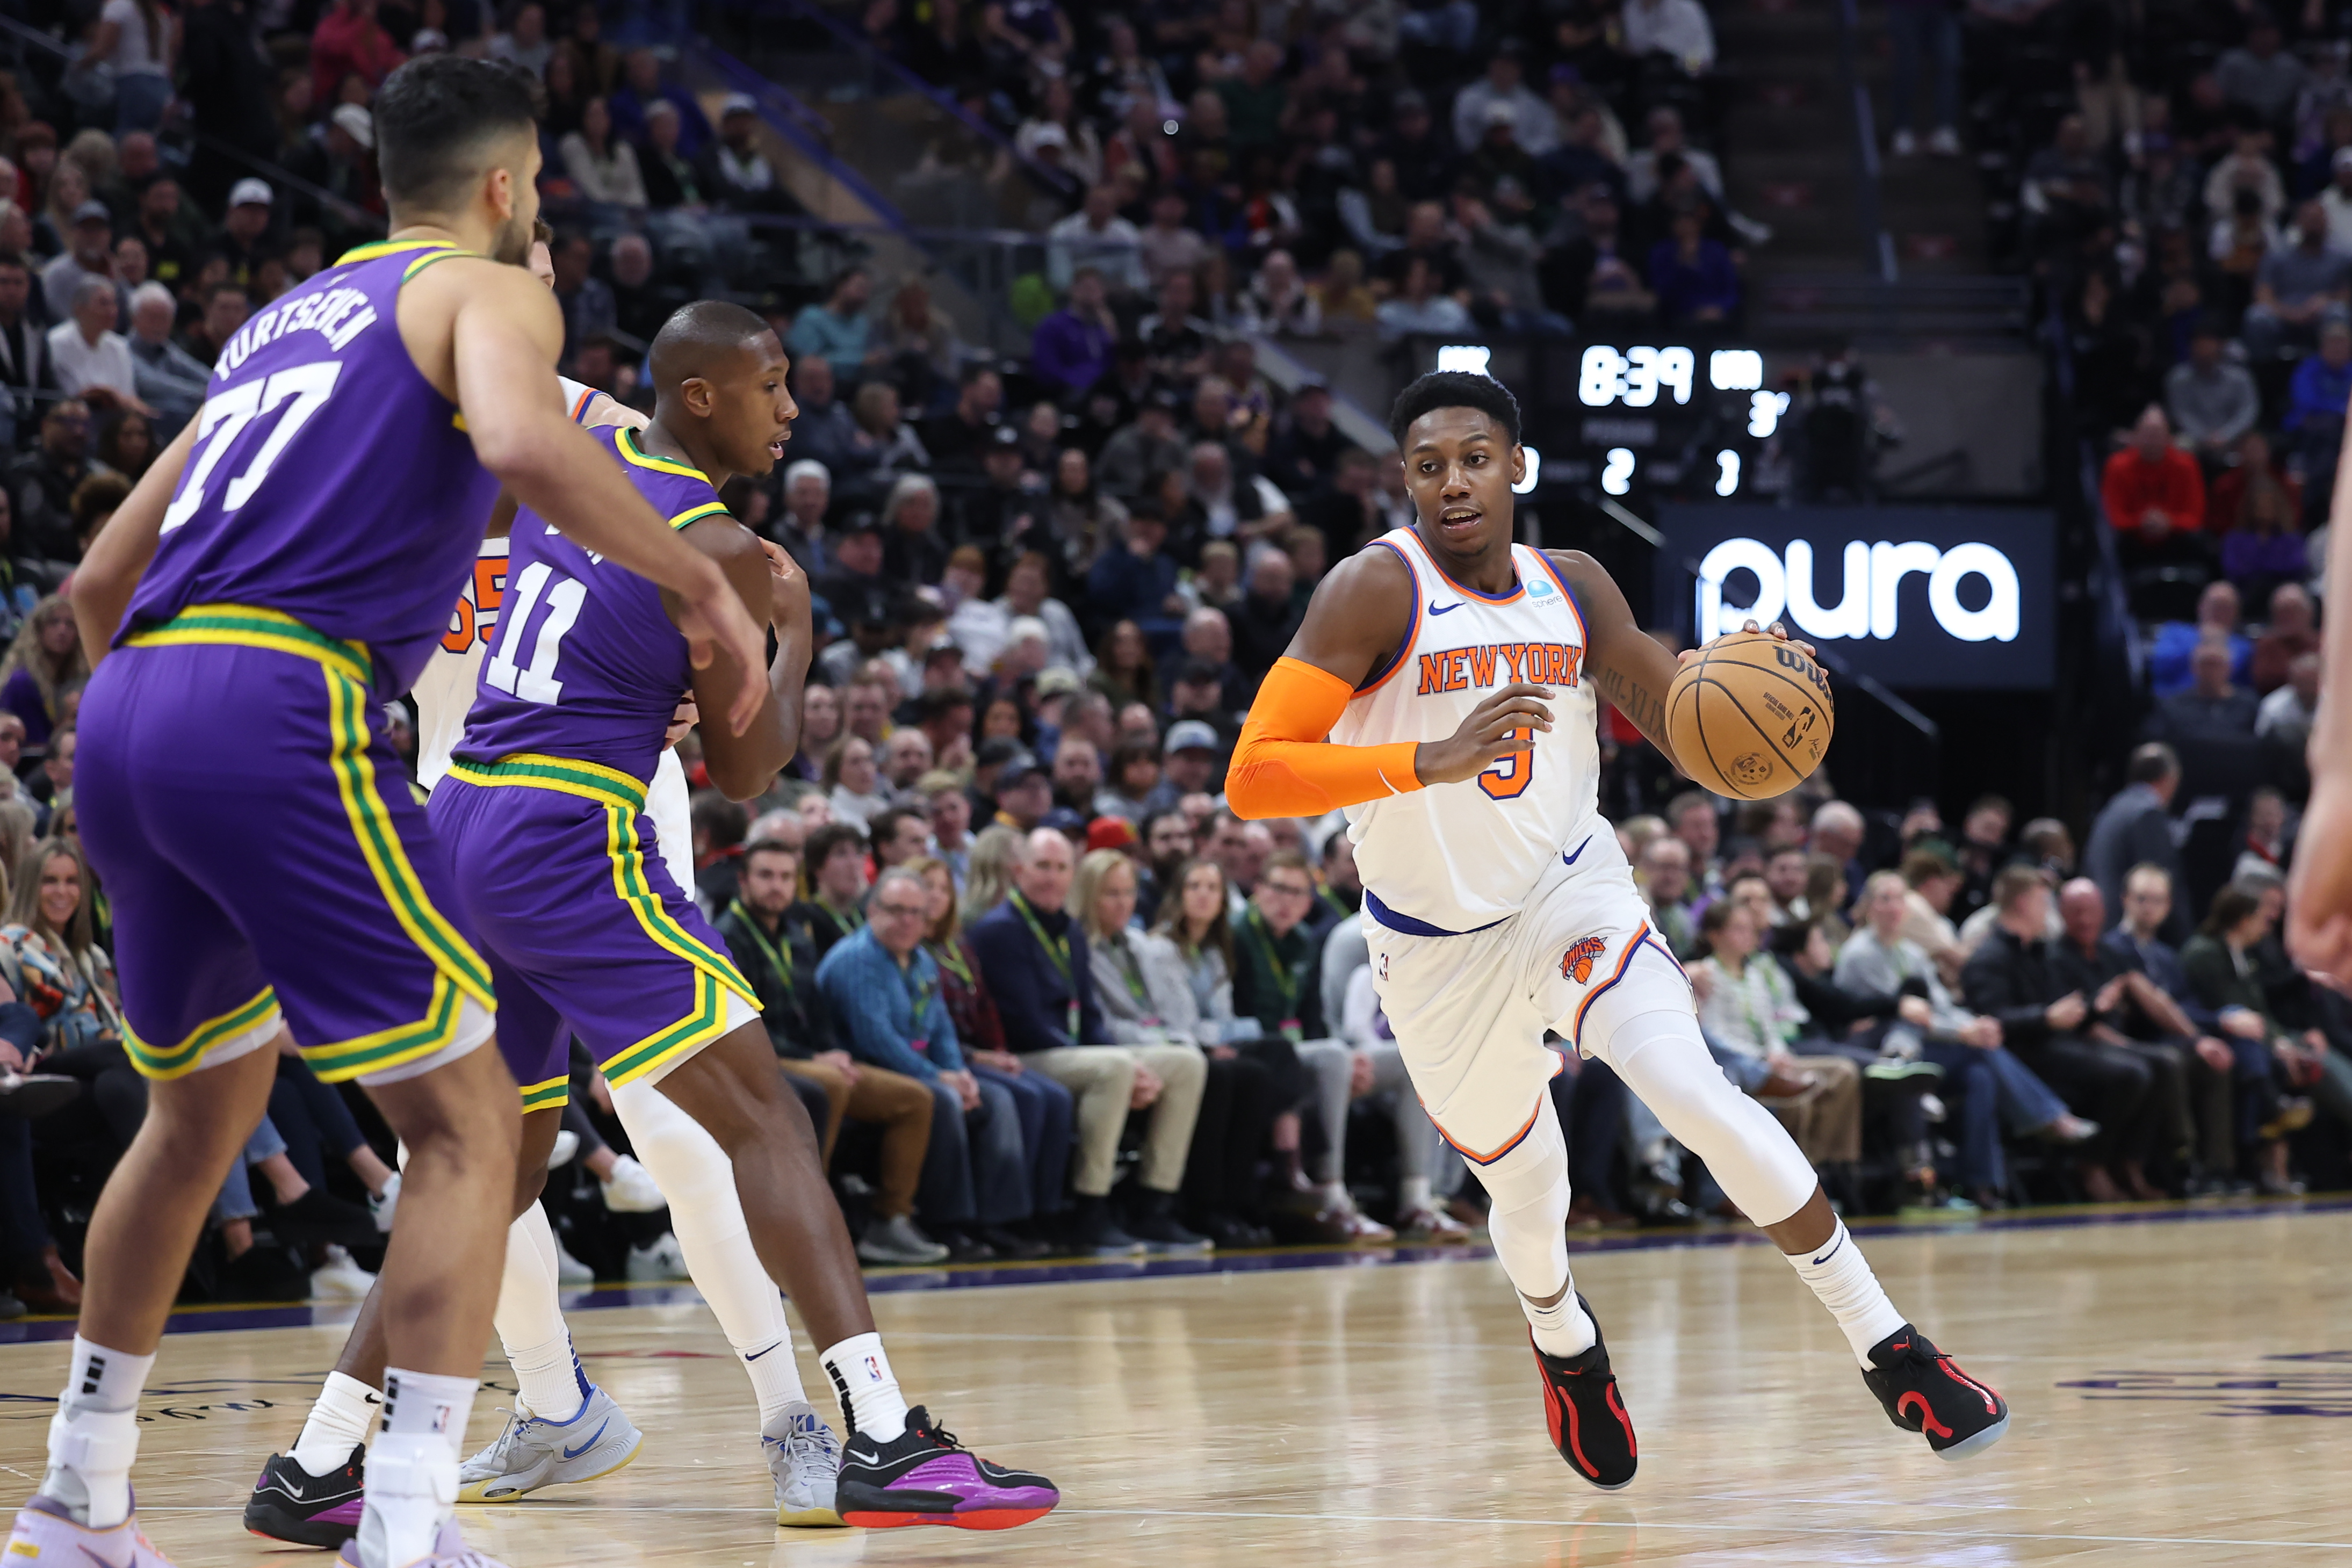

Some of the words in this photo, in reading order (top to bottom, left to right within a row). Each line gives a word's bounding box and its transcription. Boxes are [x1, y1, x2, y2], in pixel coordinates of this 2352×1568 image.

[214, 287, 377, 382] YURTSEVEN
[1578, 345, 1696, 407] 8:39
[158, 360, 344, 536] 77
[1602, 448, 1635, 495] 2
[1715, 450, 1740, 496] 1
[1532, 594, 1563, 609] sphere
[1697, 537, 2021, 645] pura
[485, 561, 588, 706] 11
[1417, 645, 1498, 697] NEW
[1500, 642, 1582, 689] YORK
[1562, 937, 1606, 980] KNICKS
[1577, 936, 1589, 945] YORK
